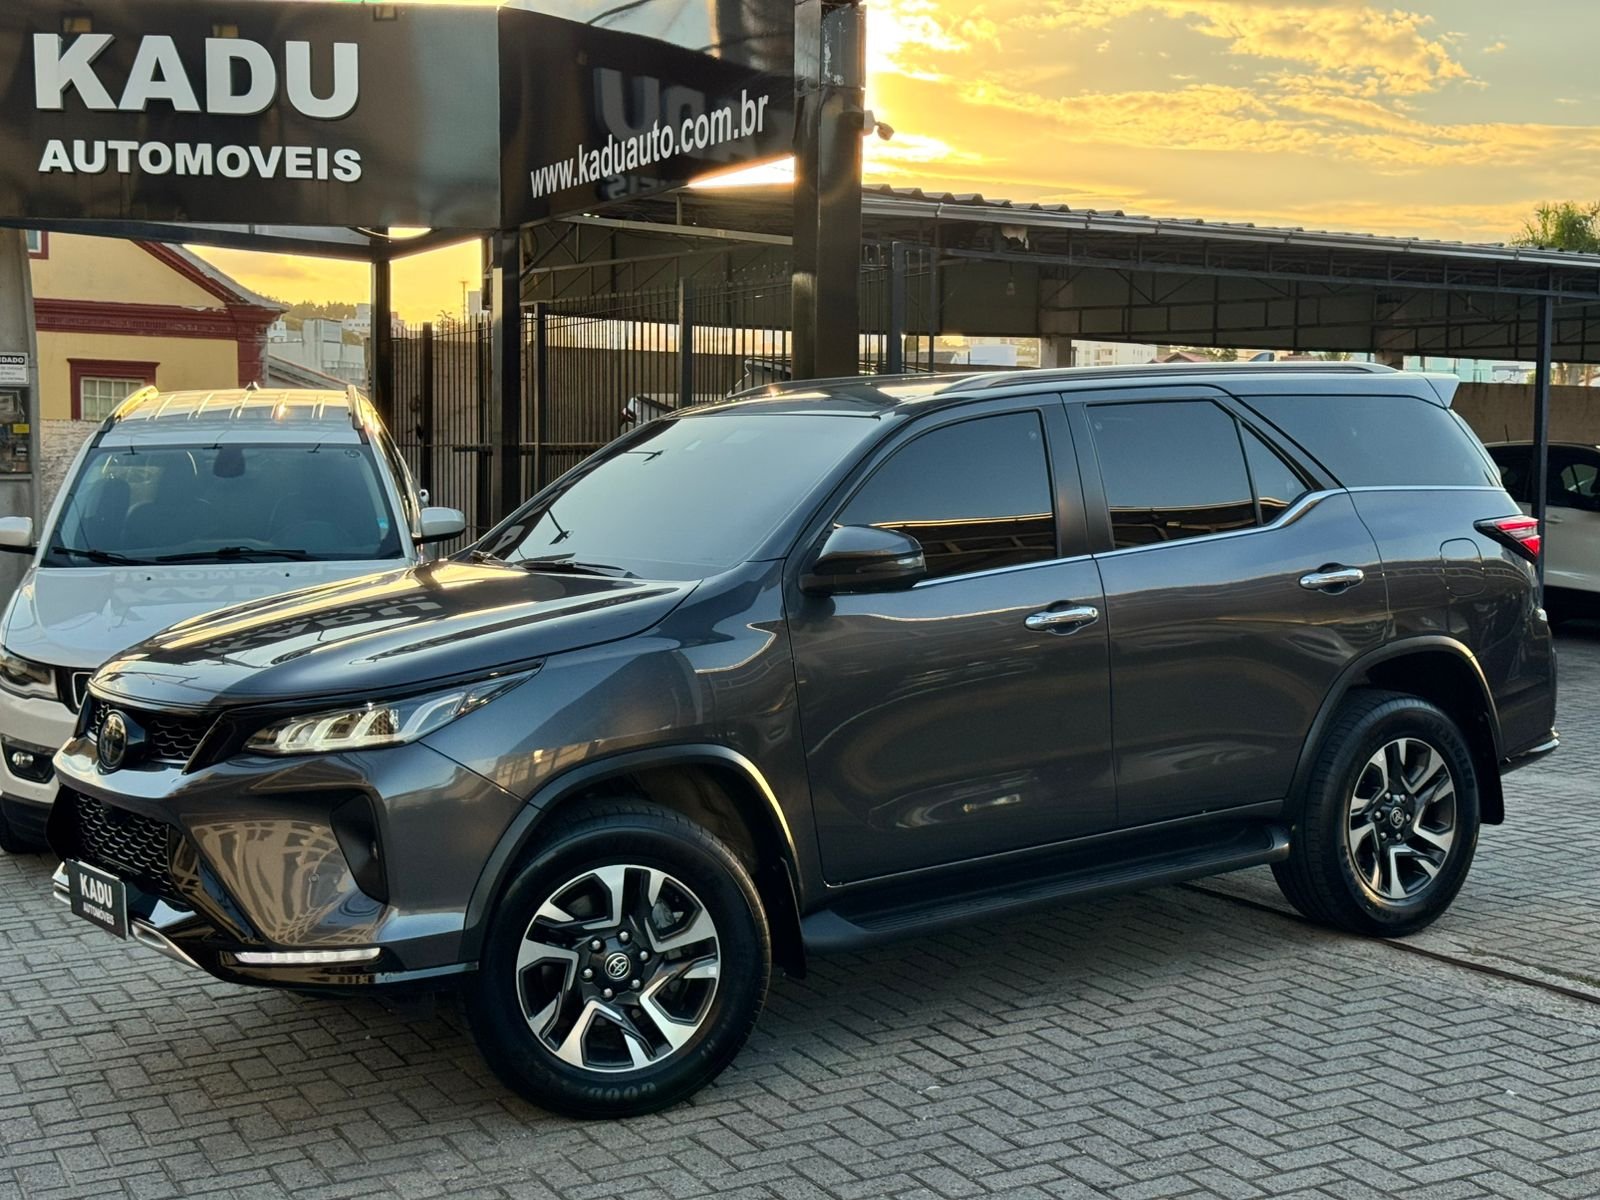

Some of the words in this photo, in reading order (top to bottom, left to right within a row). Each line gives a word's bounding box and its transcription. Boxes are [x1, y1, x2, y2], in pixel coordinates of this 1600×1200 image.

[33, 33, 359, 120] KADU
[38, 139, 362, 182] AUTOMOVEIS
[530, 89, 769, 198] www.kaduauto.com.br
[80, 873, 113, 909] KADU
